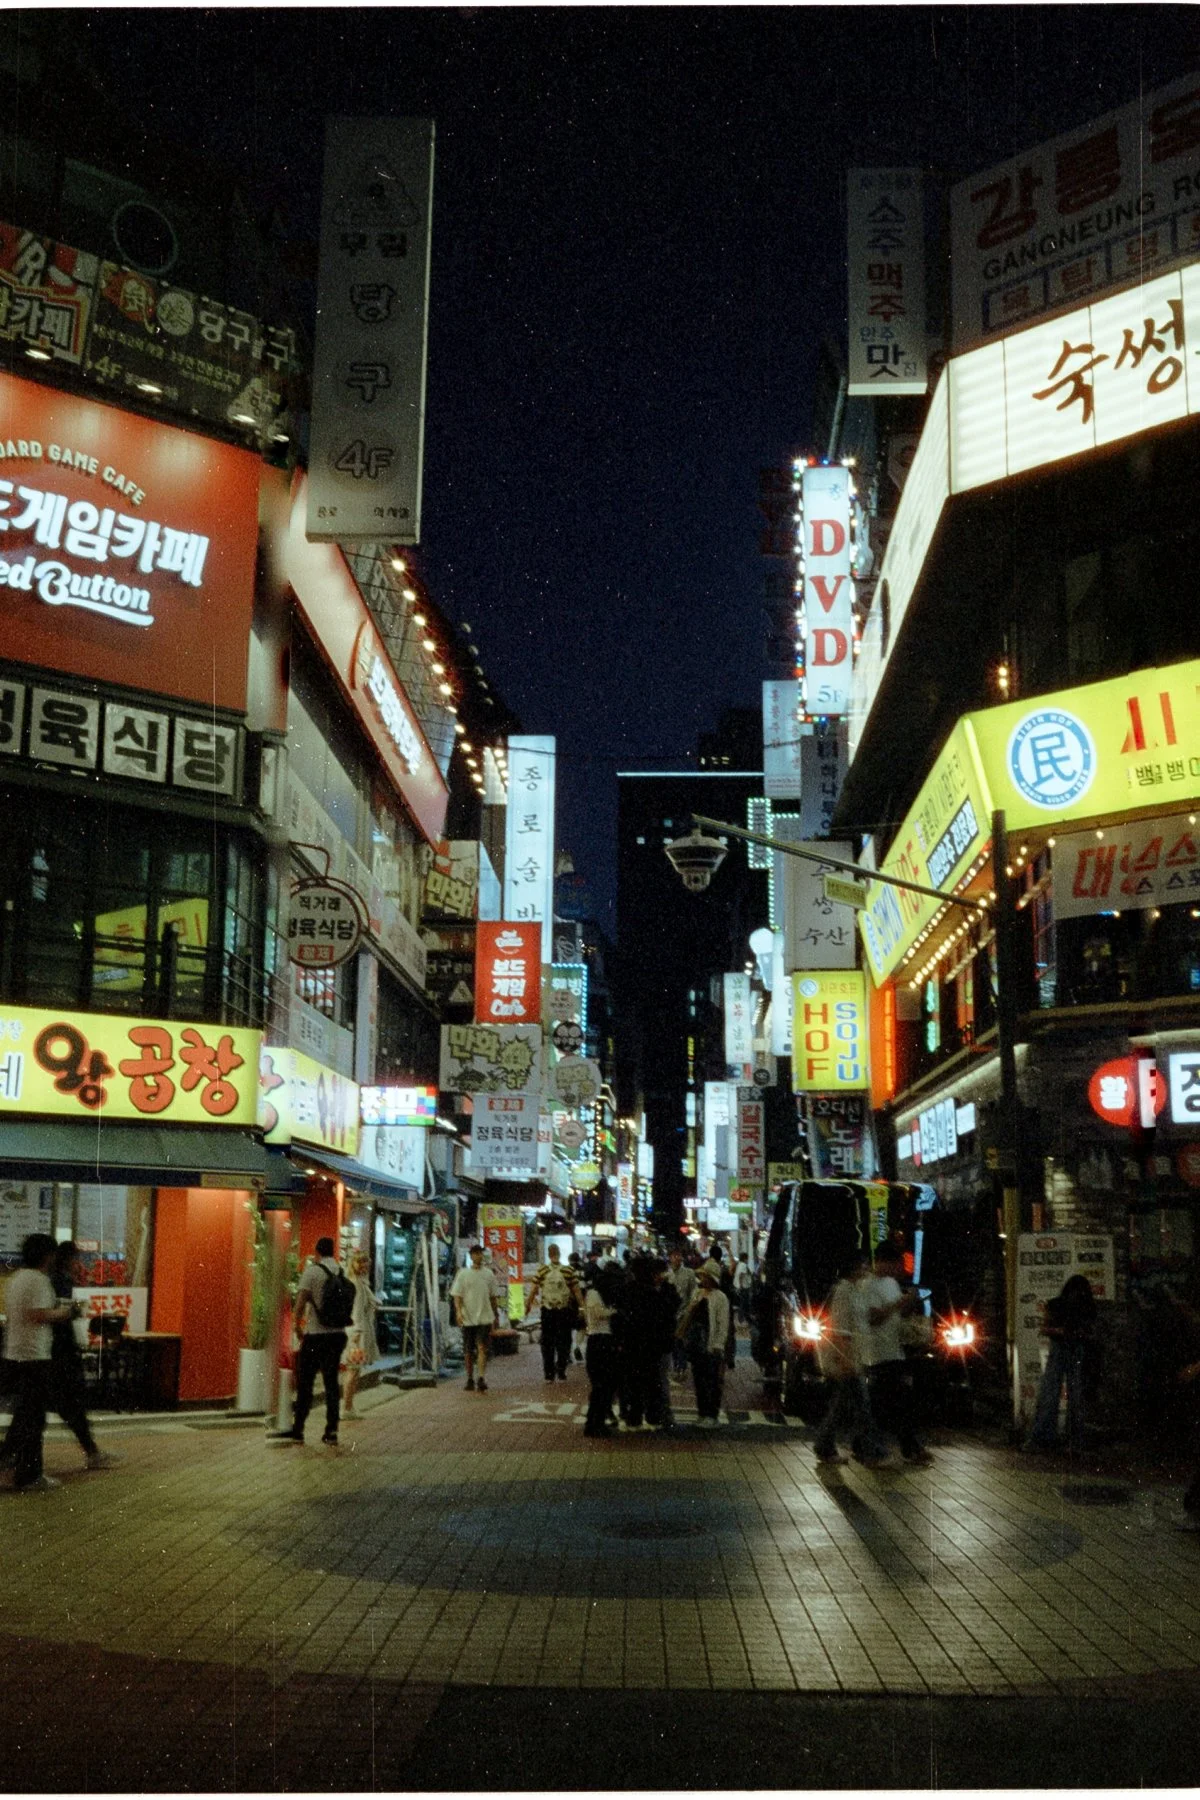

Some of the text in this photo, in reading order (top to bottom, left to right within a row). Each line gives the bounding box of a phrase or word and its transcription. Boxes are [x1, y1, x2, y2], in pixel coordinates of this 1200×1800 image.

[983, 192, 1155, 281] GANGNEUNG
[1032, 299, 1200, 424] 숙썽
[48, 443, 100, 475] GAME
[103, 466, 147, 506] CAFE
[335, 439, 393, 480] 4F
[34, 560, 152, 614] Button
[808, 519, 848, 666] DVD
[1029, 731, 1078, 789] 民
[299, 895, 341, 911] 직거래
[804, 1002, 830, 1080] HOF
[835, 1002, 860, 1081] SOJU
[477, 1126, 533, 1142] 정육식당
